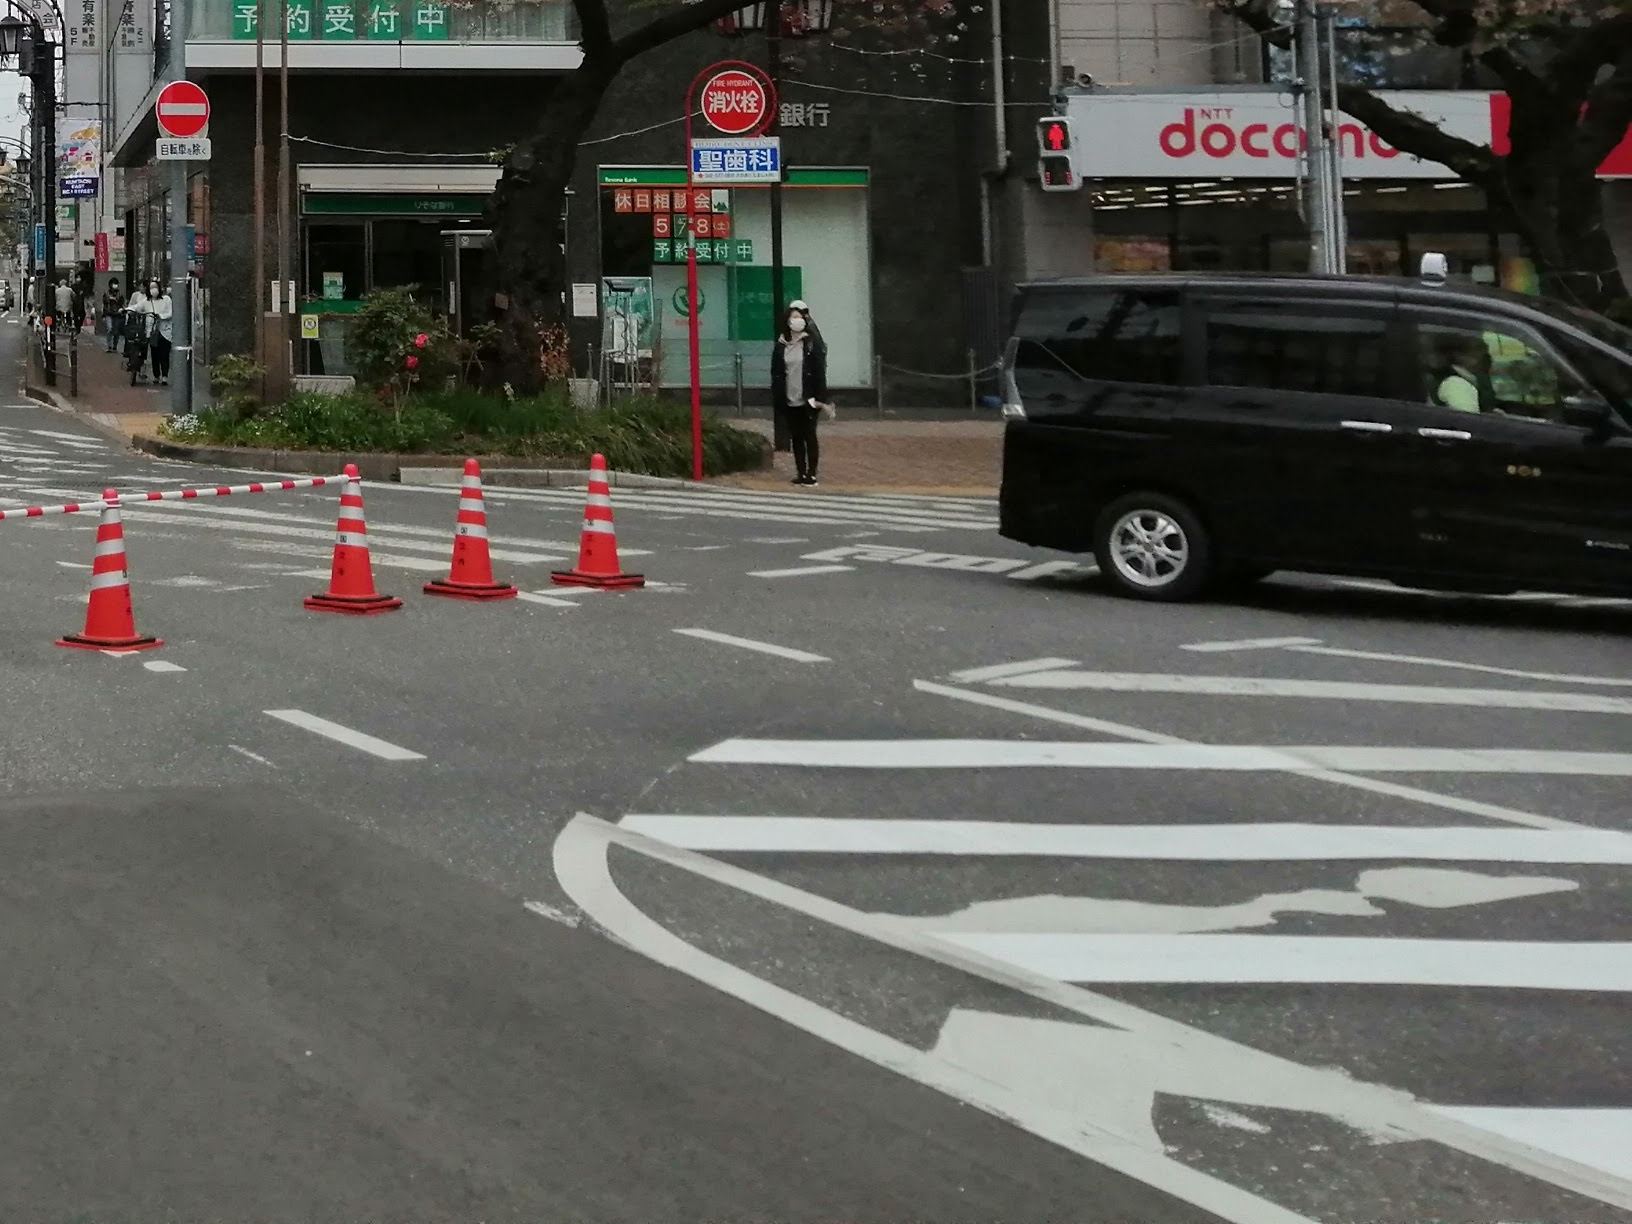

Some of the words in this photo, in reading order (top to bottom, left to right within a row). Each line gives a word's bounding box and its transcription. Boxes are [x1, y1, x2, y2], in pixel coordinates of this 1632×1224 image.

[233, 4, 445, 35] 予約受付中
[708, 90, 760, 114] 消火栓
[779, 102, 831, 127] 銀行
[1200, 108, 1234, 120] NTT
[160, 143, 207, 156] 自転車を除く
[698, 148, 774, 172] 聖歯科
[615, 193, 711, 210] 休日相談会
[654, 242, 753, 259] 予約受付中
